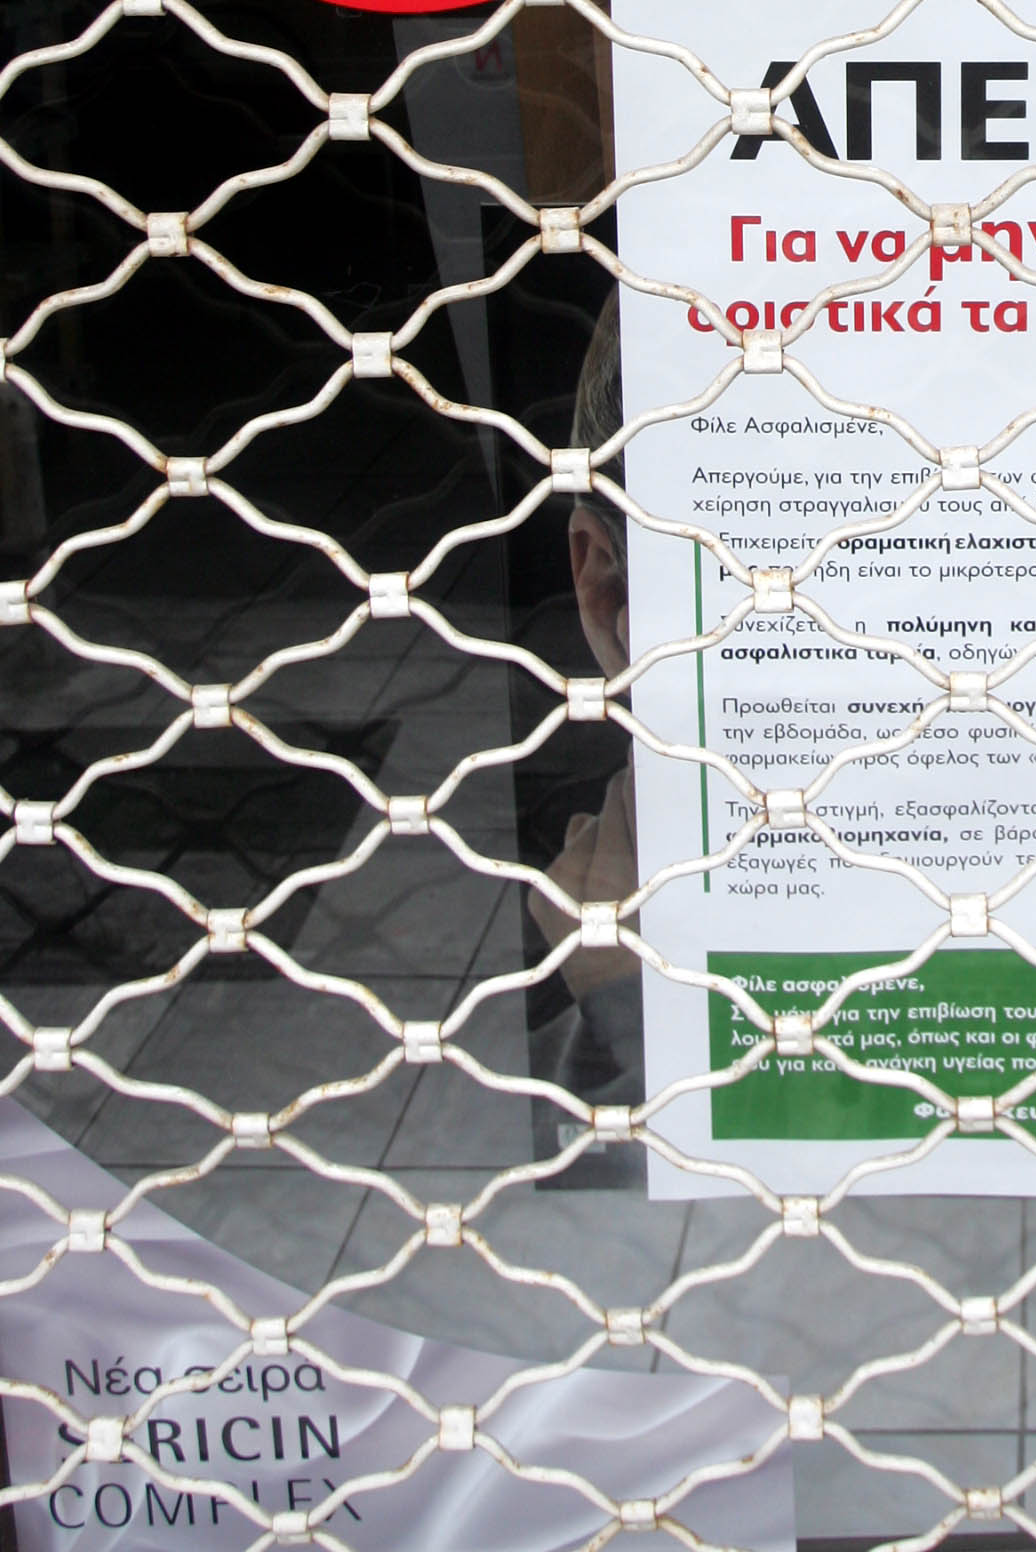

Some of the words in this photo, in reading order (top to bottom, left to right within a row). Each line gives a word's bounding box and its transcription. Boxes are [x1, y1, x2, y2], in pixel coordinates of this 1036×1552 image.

[730, 215, 816, 263] Για
[836, 229, 906, 263] να
[961, 299, 1028, 333] τα
[690, 416, 737, 434] Φίλε
[743, 415, 884, 438] Ασφαλισμένε,
[691, 467, 809, 489] Απεργούμε,
[814, 472, 842, 489] για
[850, 471, 883, 489] την
[692, 496, 772, 517] χείρηση
[937, 499, 983, 516] τους
[858, 561, 901, 578] είναι
[909, 565, 932, 578] το
[855, 621, 867, 634] η
[887, 616, 993, 638] πολύμηνη
[722, 697, 837, 718] Προωθείται
[722, 727, 754, 743] την
[763, 723, 868, 744] εβδομάδα,
[907, 749, 980, 769] όφελος
[987, 752, 1021, 764] των
[725, 801, 761, 821] Την
[815, 802, 885, 821] στιγμή,
[959, 830, 985, 842] σε
[727, 853, 818, 874] εξαγωγές
[727, 880, 779, 899] χώρα
[786, 883, 825, 900] μας.
[867, 1009, 901, 1025] την
[907, 1001, 997, 1023] επιβίωση
[860, 1033, 902, 1051] μας,
[908, 1028, 961, 1047] όπως
[965, 1031, 996, 1044] και
[1001, 1031, 1020, 1044] οι
[776, 1059, 806, 1076] για
[943, 1053, 1005, 1073] υγείας
[65, 1356, 163, 1397] Νέα
